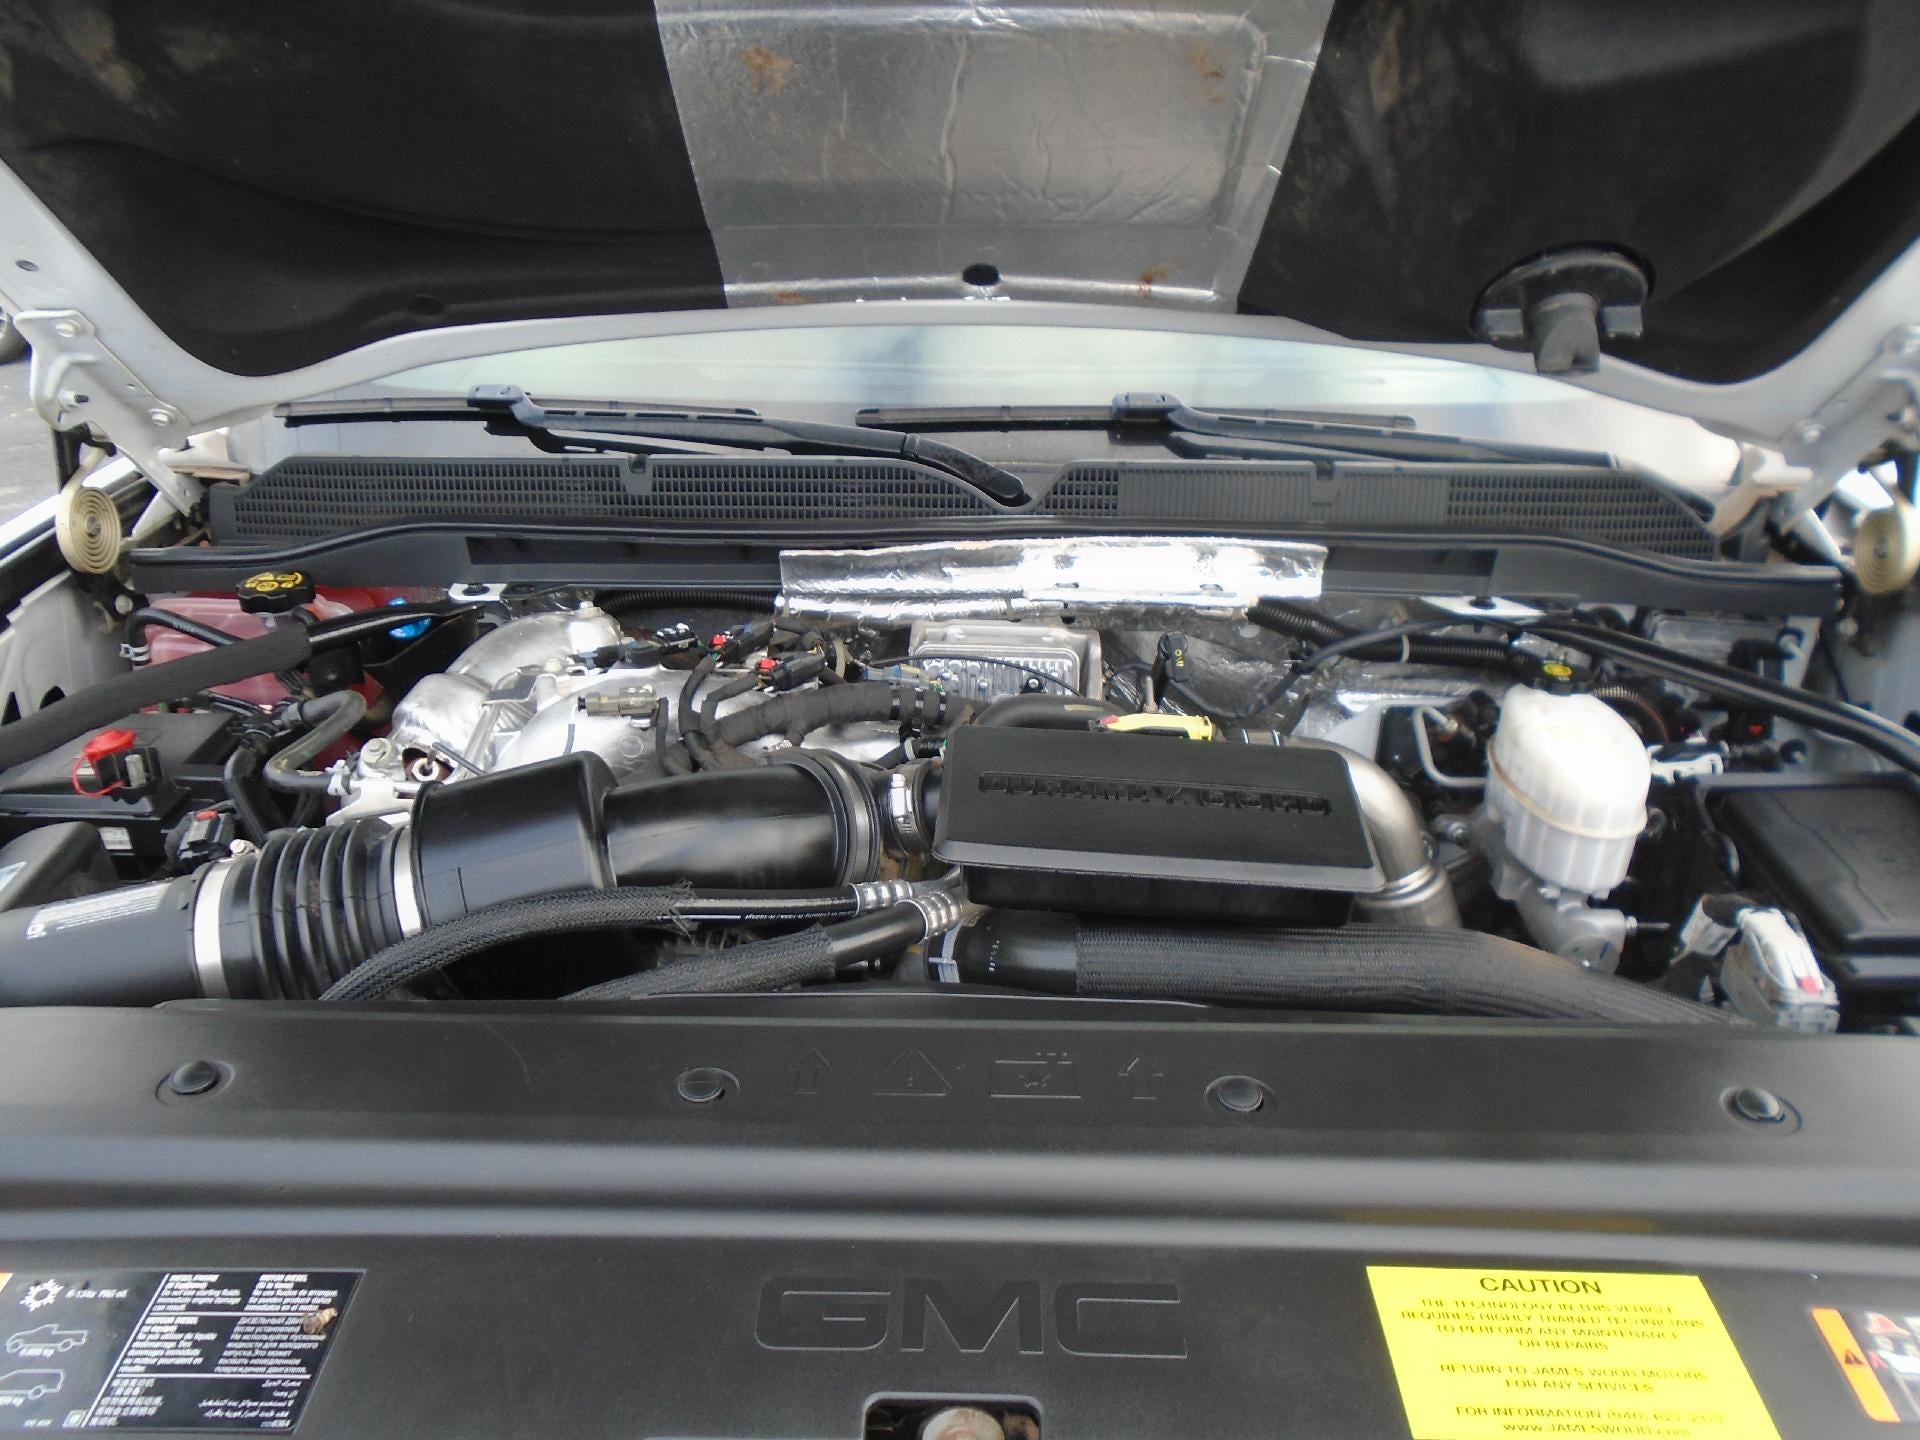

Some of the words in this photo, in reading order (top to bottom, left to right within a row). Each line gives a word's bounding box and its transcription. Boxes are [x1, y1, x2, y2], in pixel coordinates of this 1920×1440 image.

[1479, 1277, 1602, 1294] CAUTION
[1454, 1300, 1553, 1310] TECHNOLOGY
[1558, 1303, 1574, 1311] IN
[1615, 1304, 1674, 1314] VEHICLE
[754, 1277, 1188, 1359] GMC
[1400, 1310, 1475, 1320] REQUIRES
[1480, 1312, 1532, 1322] HIGHLY
[1539, 1314, 1601, 1324] TRAINED
[1607, 1316, 1704, 1327] TECHNICIANS
[1436, 1323, 1455, 1333] TO
[1459, 1324, 1533, 1335] PERFORM
[1539, 1327, 1566, 1336] ANY
[1572, 1328, 1680, 1340] MAINTENANCE
[1518, 1339, 1541, 1348] OR
[1545, 1340, 1609, 1350] REPAIRS
[1440, 1363, 1502, 1374] RETURN
[1507, 1365, 1527, 1374] TO
[1533, 1366, 1584, 1377] JAMES
[1588, 1368, 1637, 1378] WOOD
[1641, 1370, 1708, 1381] MOTORS
[1505, 1378, 1537, 1389] FOR
[1543, 1379, 1571, 1390] ANY
[1577, 1381, 1655, 1392] SERVICES
[1455, 1405, 1488, 1416] FOR
[1492, 1407, 1602, 1419] INFORMATION
